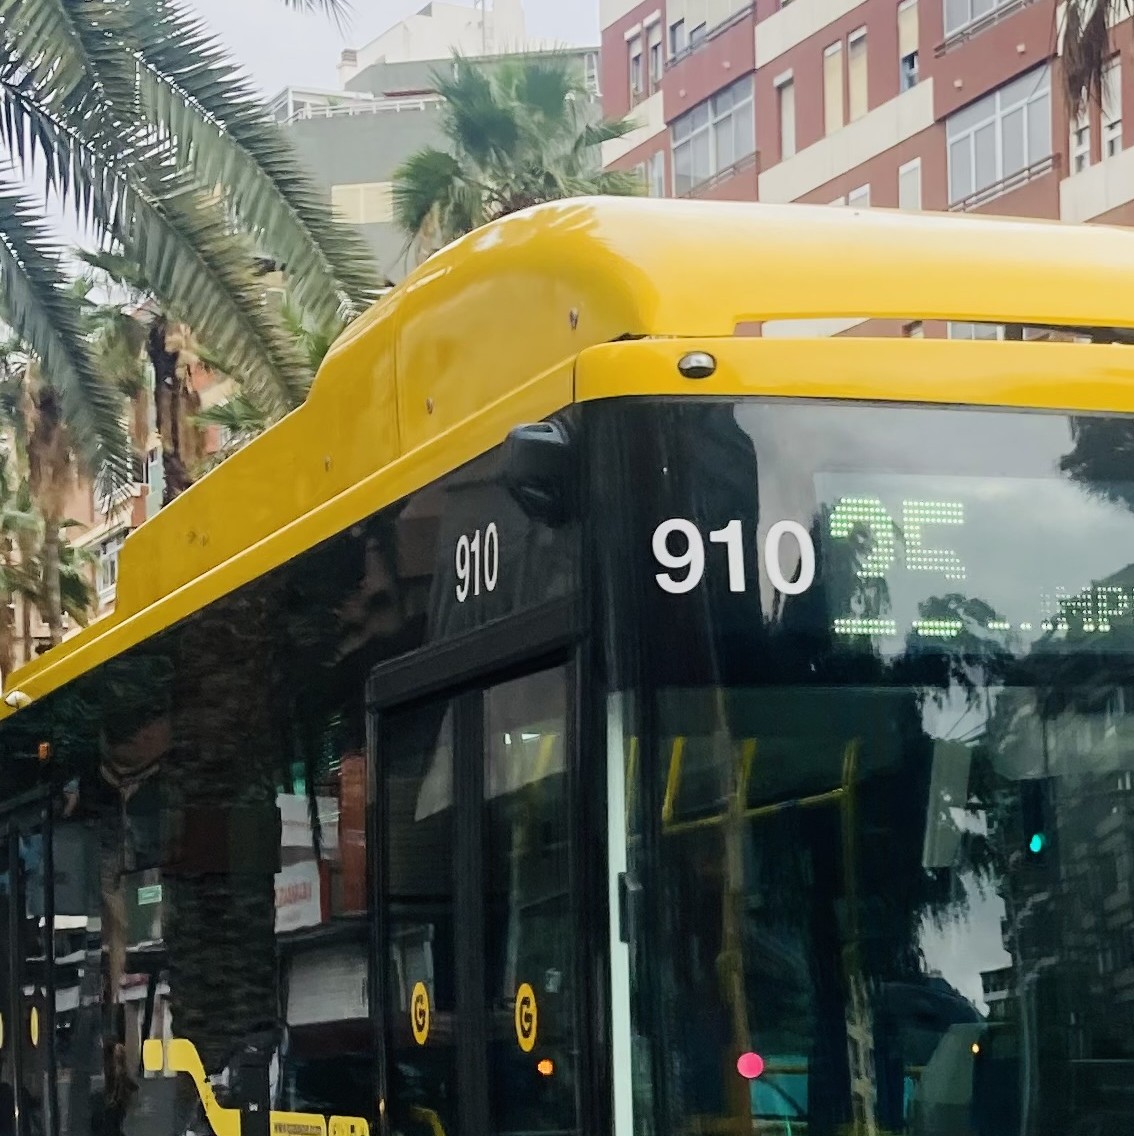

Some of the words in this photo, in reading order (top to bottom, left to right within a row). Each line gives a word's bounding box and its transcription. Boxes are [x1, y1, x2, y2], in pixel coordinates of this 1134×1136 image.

[455, 522, 499, 603] 910
[651, 518, 816, 595] 910
[829, 497, 966, 637] 25
